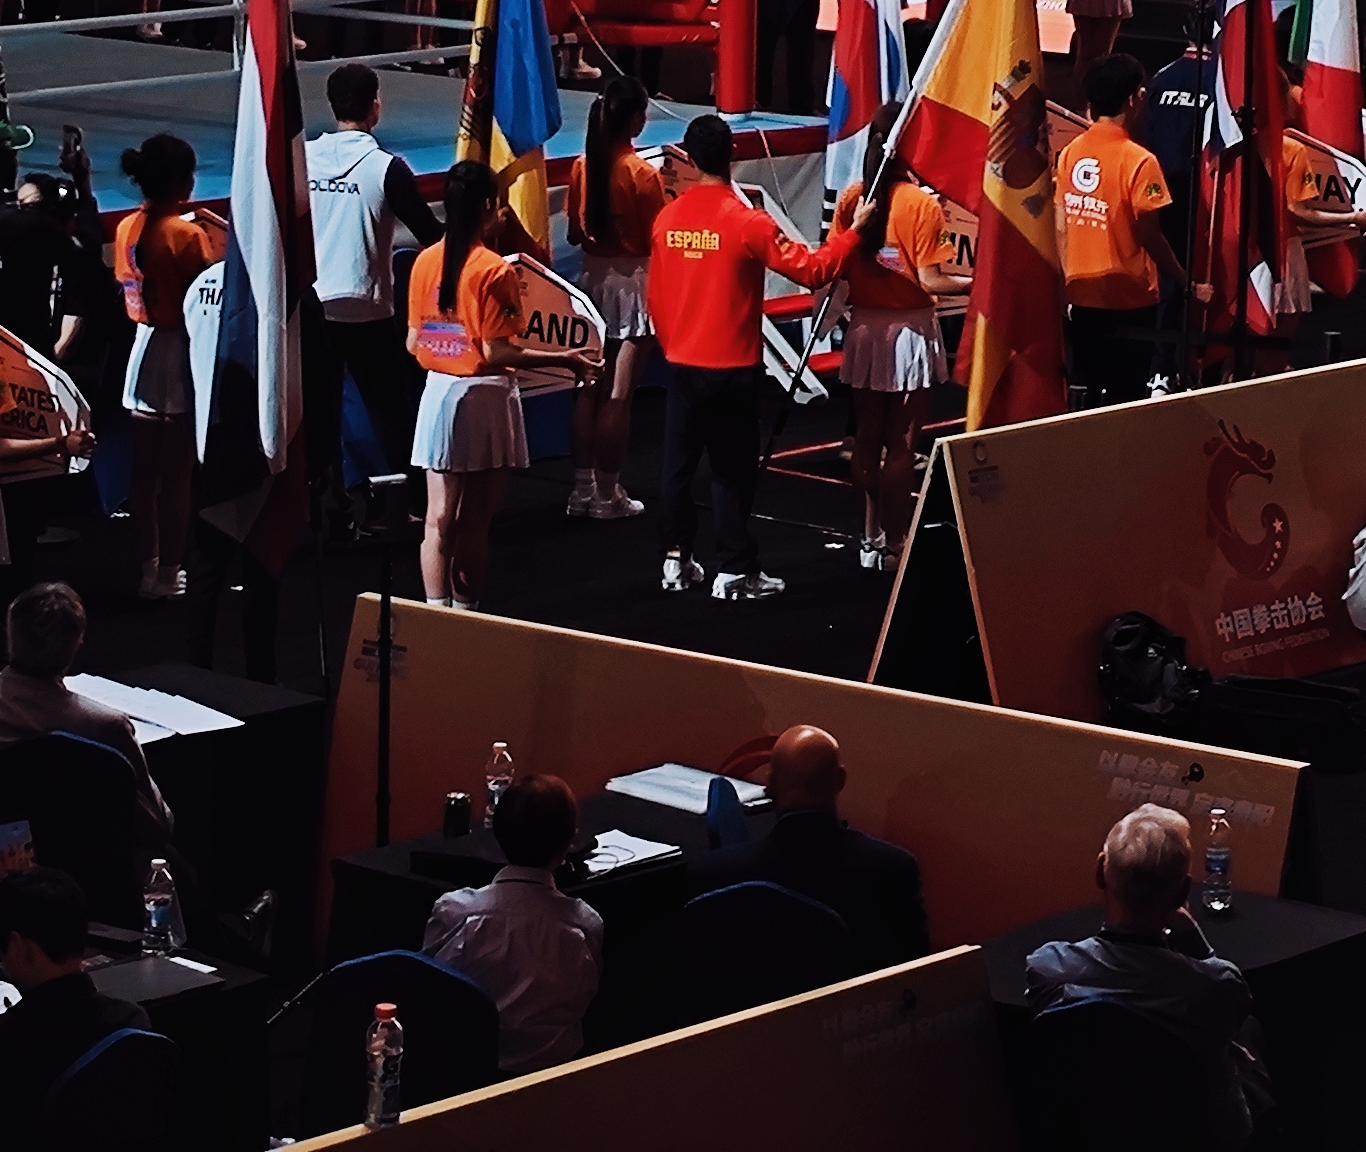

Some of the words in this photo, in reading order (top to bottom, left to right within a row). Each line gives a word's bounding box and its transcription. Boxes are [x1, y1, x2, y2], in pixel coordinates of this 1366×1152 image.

[310, 179, 361, 195] OLDOVA
[667, 229, 720, 251] ESPAÑA
[8, 383, 61, 414] TATES
[1, 408, 49, 435] ERICA
[1214, 591, 1326, 643] 中国拳击协会
